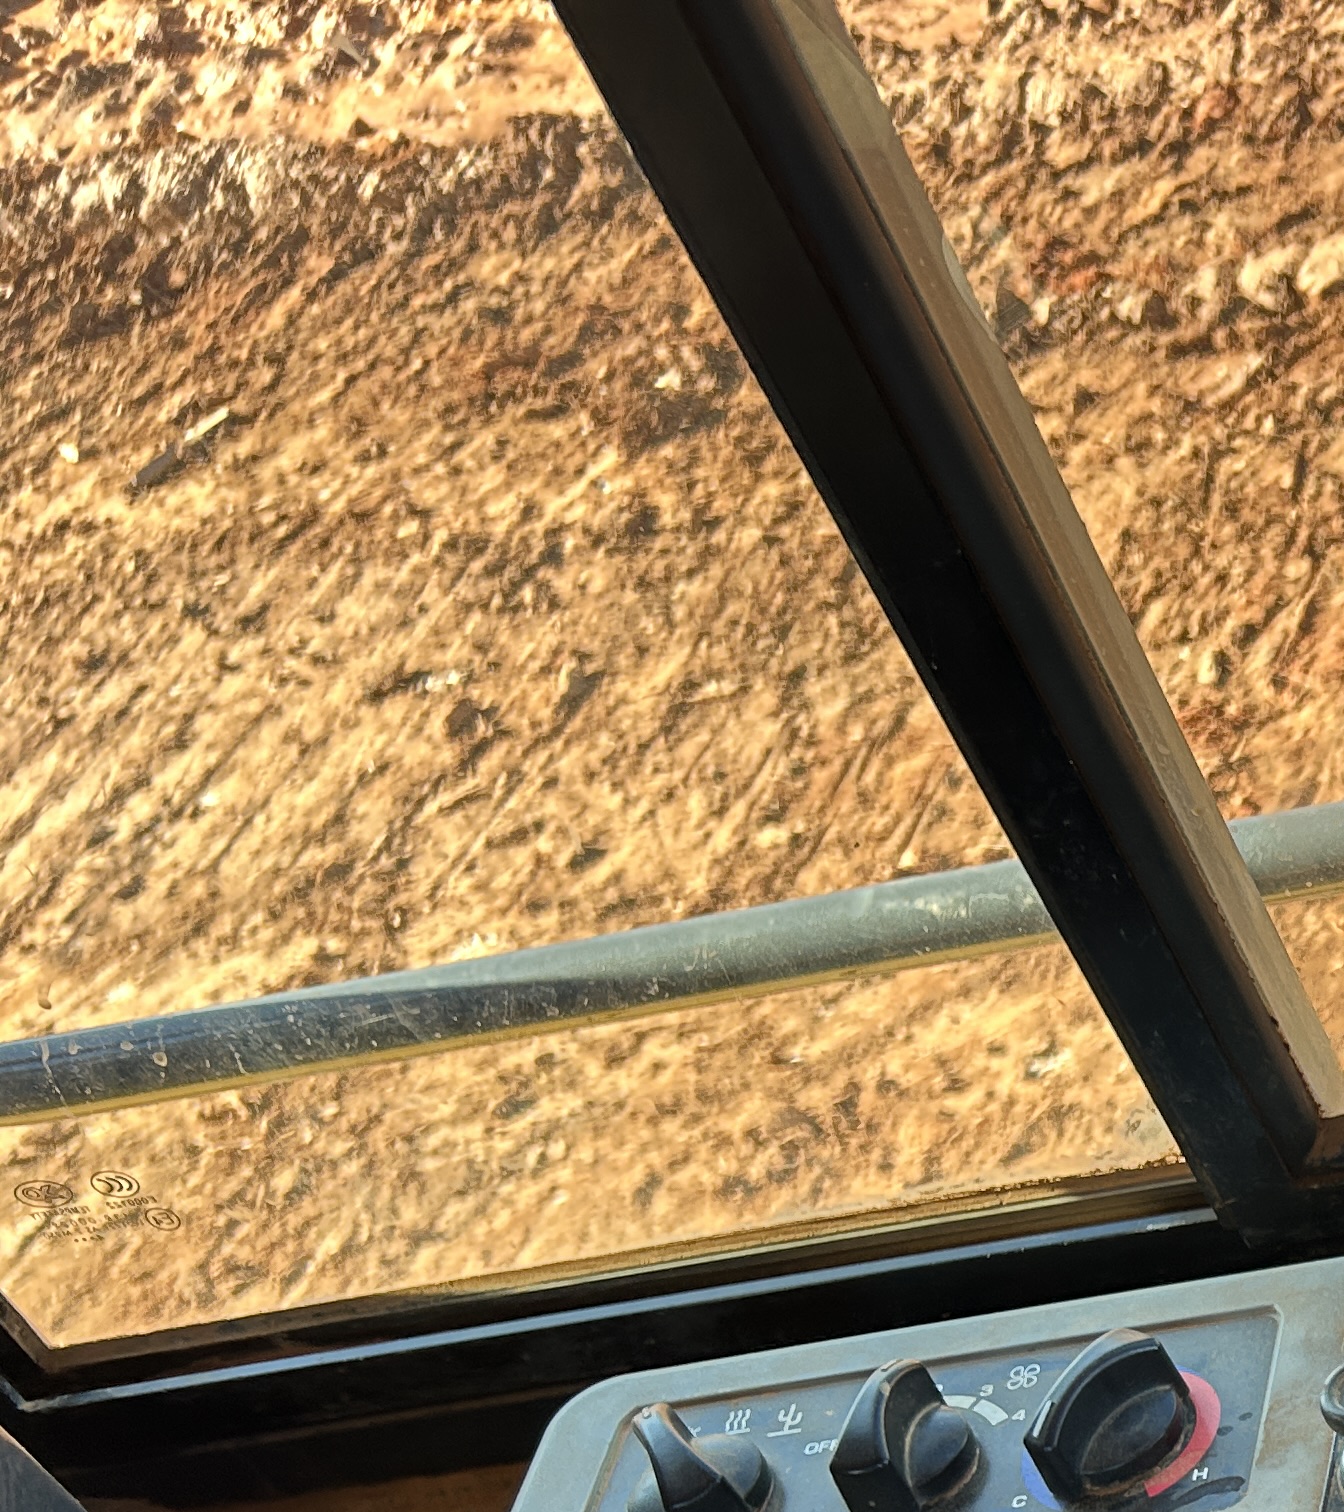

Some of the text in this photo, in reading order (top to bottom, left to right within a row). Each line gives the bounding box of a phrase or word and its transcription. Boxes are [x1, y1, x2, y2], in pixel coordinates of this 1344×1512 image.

[979, 1385, 994, 1397] 3
[1011, 1409, 1026, 1421] 4
[1192, 1467, 1209, 1482] H
[1011, 1495, 1027, 1508] C
